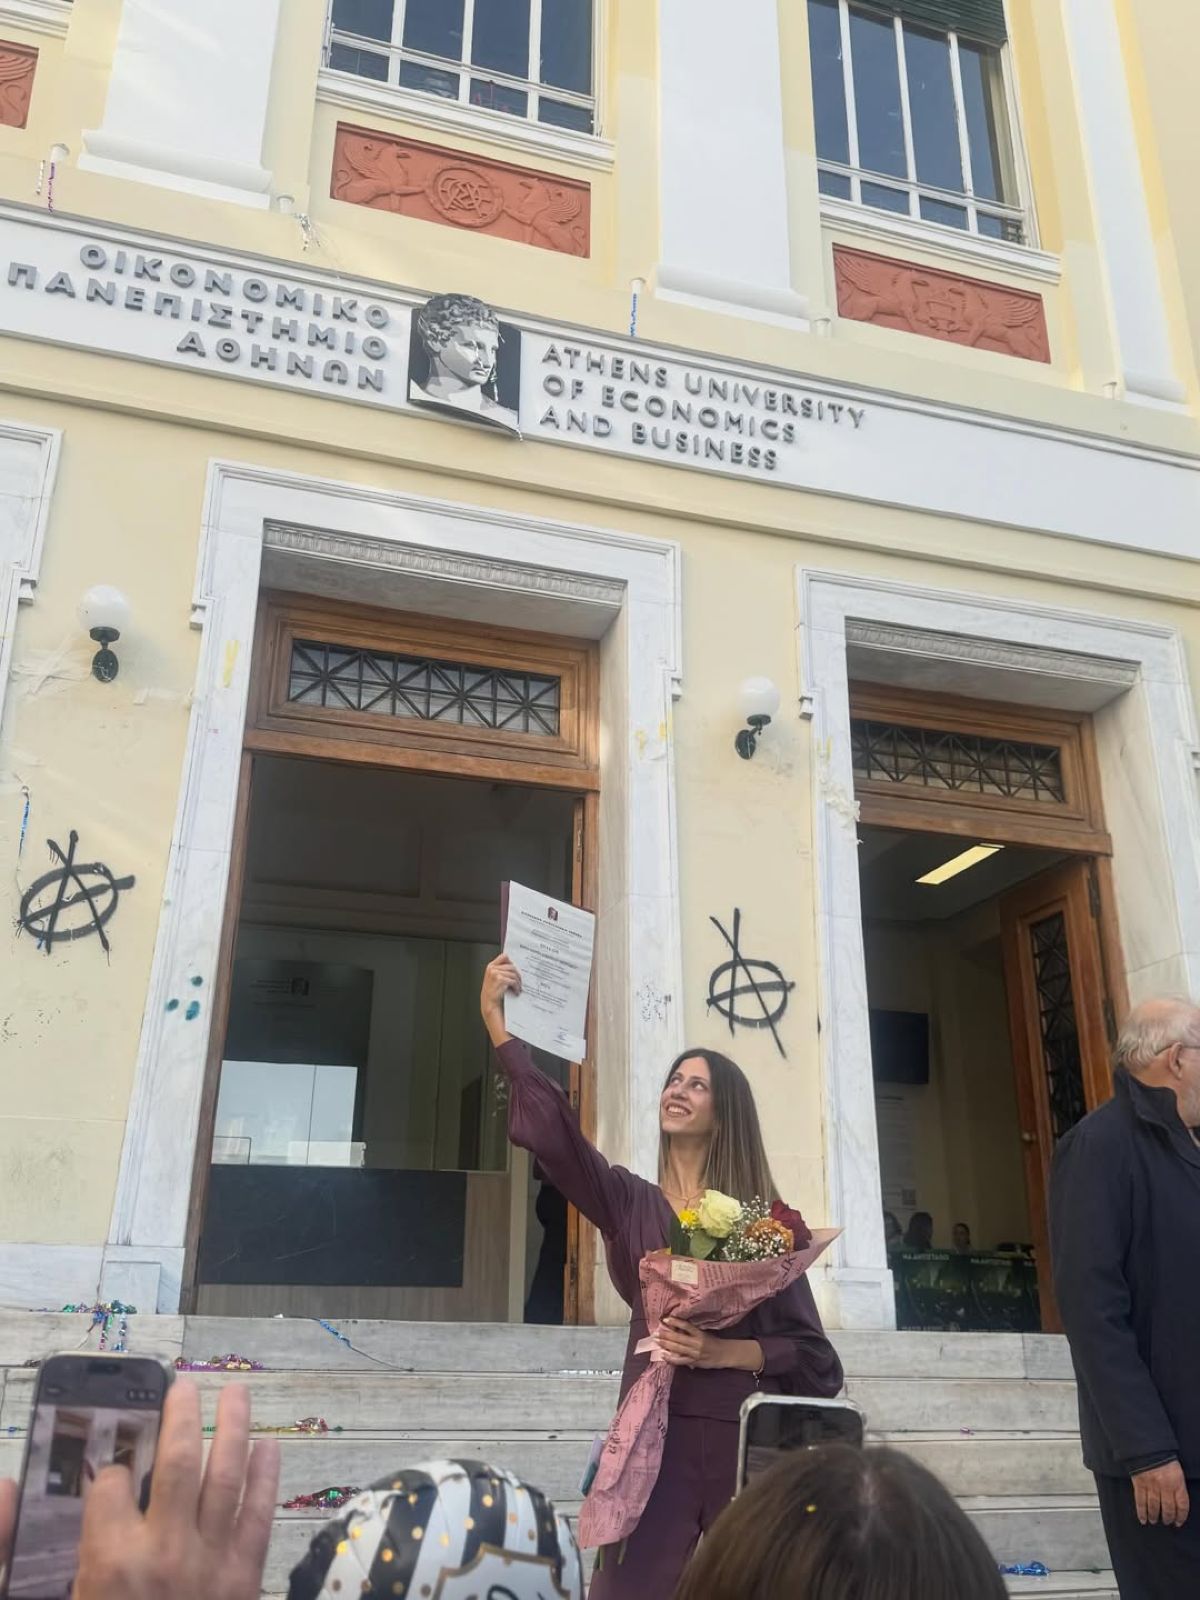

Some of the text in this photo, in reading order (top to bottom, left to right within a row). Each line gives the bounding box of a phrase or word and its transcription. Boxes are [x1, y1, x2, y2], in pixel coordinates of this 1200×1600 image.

[7, 261, 387, 360] ΠΑΝΕΠΙΣΤΗΜΙΟ
[80, 243, 389, 328] ΟΙΚΟΝΟΜΙΚΟ
[176, 331, 384, 392] ΑΘΗΝΩΝ
[542, 343, 866, 428] ATHENS UNIVERSITY
[539, 406, 777, 471] AND BUSINESS
[542, 373, 796, 445] OF ECONOMICS
